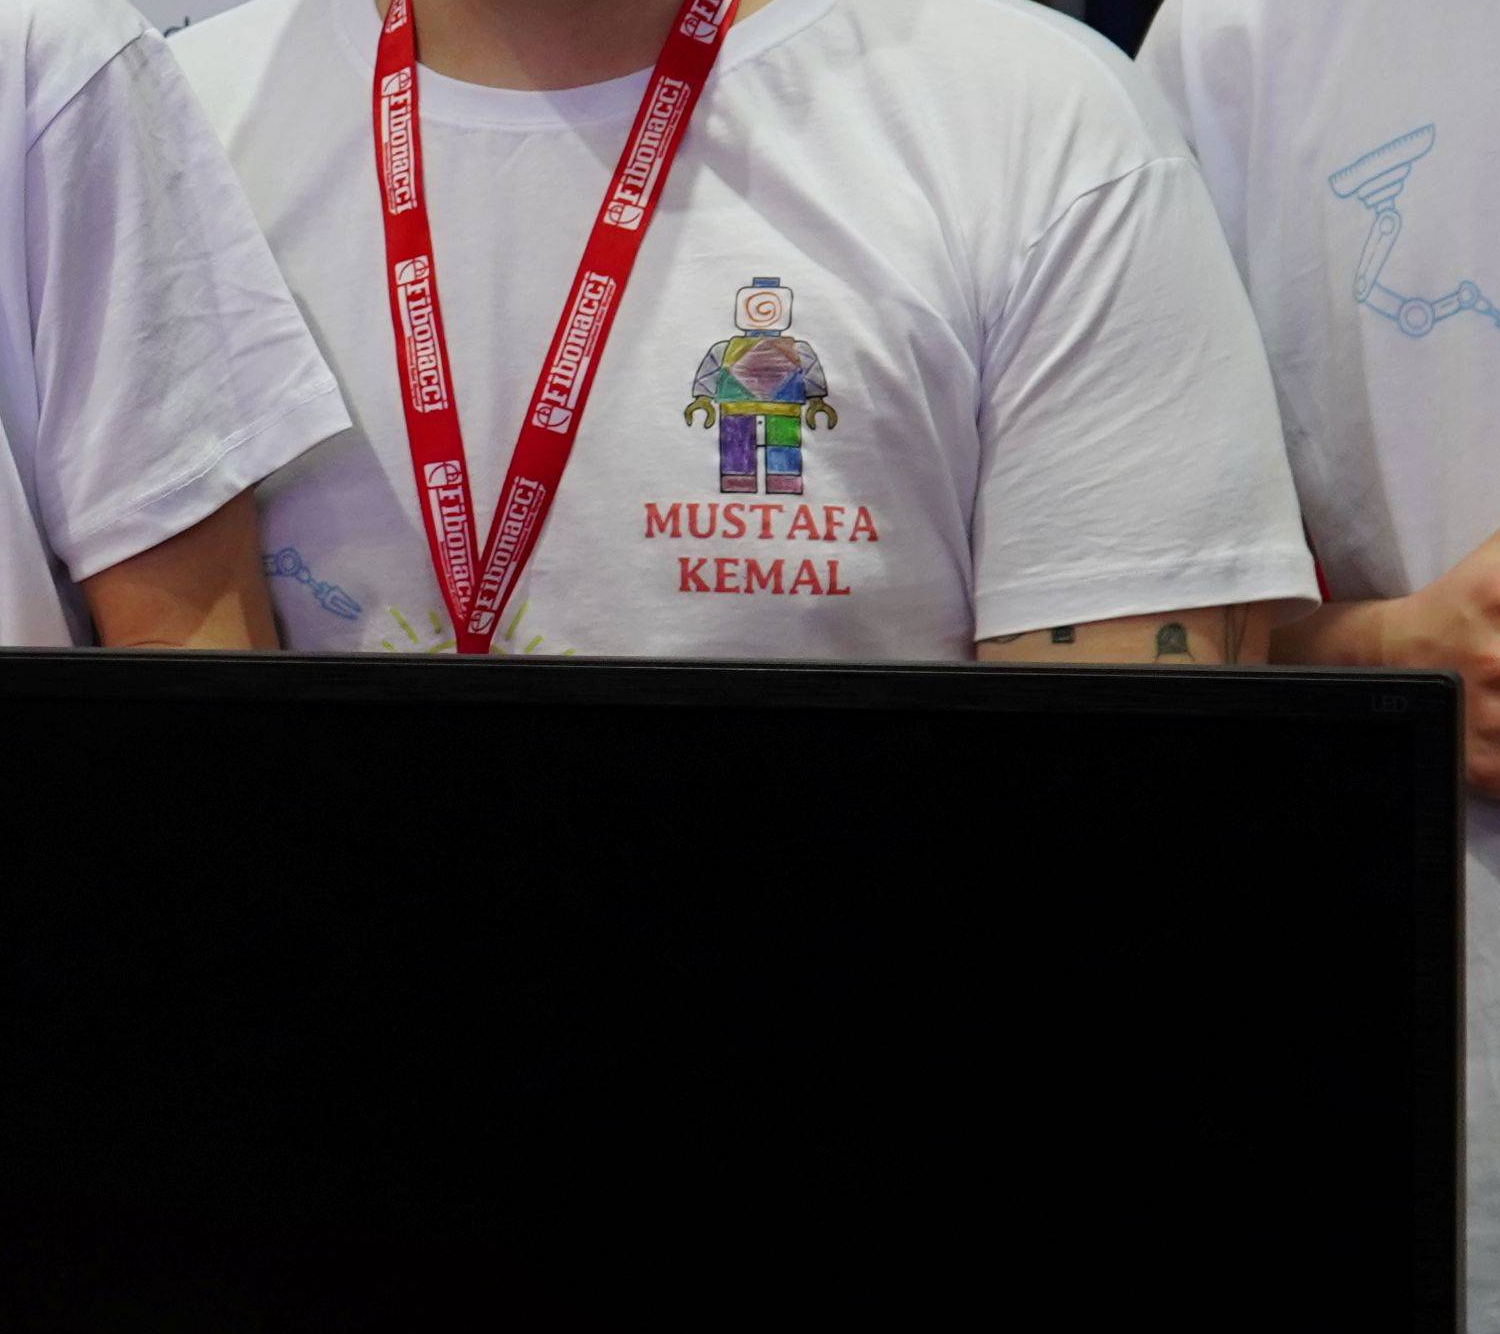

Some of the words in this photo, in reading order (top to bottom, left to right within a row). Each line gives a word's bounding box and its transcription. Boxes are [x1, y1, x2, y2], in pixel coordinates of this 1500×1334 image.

[388, 91, 418, 214] Fibonacci
[617, 75, 684, 205] Fibonacci
[404, 279, 449, 414] Fibonacci
[544, 269, 609, 407] Fibonacci
[478, 475, 539, 608] Fibonacci
[643, 502, 880, 543] MUSTAFA
[677, 556, 852, 596] KEMAL
